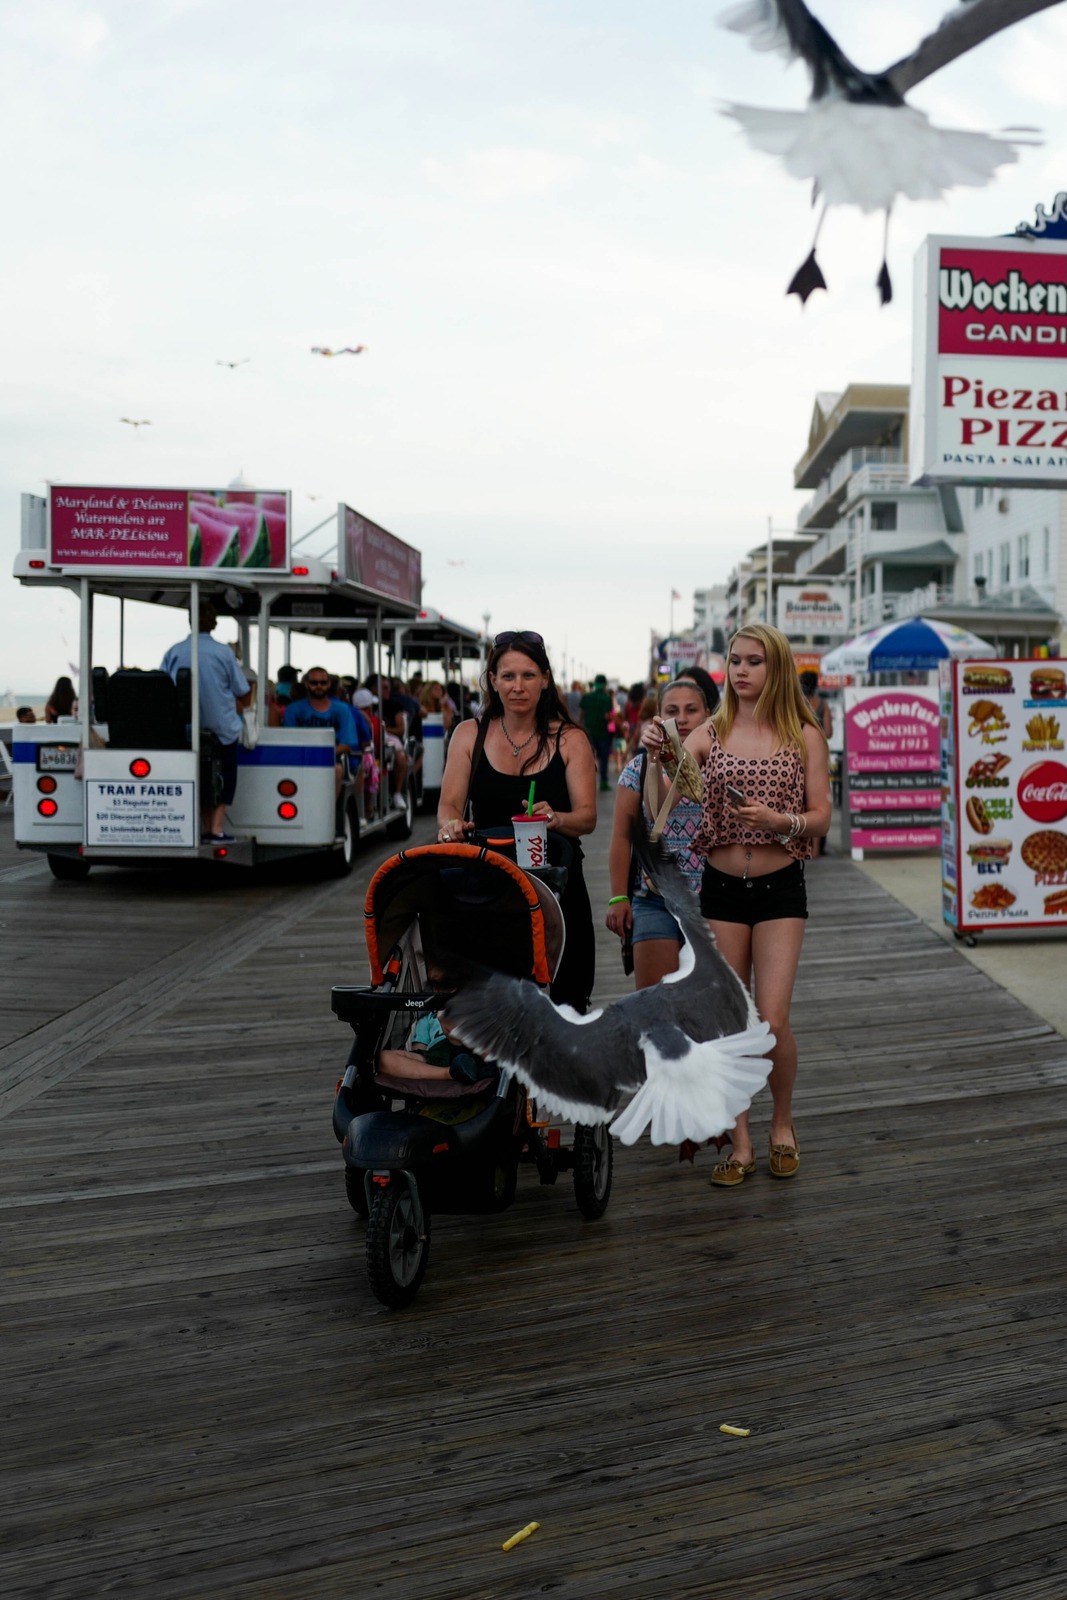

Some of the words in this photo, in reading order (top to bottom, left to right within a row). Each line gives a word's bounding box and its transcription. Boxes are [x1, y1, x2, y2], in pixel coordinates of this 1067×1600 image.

[965, 322, 1067, 344] CANDI
[942, 376, 1067, 412] Pieza
[943, 453, 995, 465] PASTA
[56, 494, 116, 511] Maryland
[116, 497, 129, 510] &
[132, 496, 184, 511] Delaware
[75, 510, 145, 526] Watermelons
[147, 516, 166, 526] are
[71, 527, 169, 541] MAR-DELicious
[786, 600, 842, 613] Boardwalk
[853, 699, 940, 729] Wockenfuss
[867, 724, 928, 737] CANDIES
[867, 738, 897, 751] Since
[900, 737, 929, 751] 1915
[965, 776, 1010, 789] GYROS
[98, 785, 136, 796] TRAM
[140, 785, 183, 797] FARES
[122, 799, 150, 809] Regular
[151, 799, 168, 807] Fare
[984, 797, 1014, 809] CHILI
[110, 813, 142, 821] Discount
[167, 813, 185, 821] Card
[886, 813, 913, 824] Covered
[985, 809, 1014, 821] DOGS
[110, 826, 144, 835] Unlimited
[145, 826, 162, 834] Ride
[163, 826, 181, 835] Pass
[871, 833, 907, 844] Caramel
[908, 832, 937, 844] Apples
[977, 862, 1003, 874] BLT
[1034, 869, 1067, 887] PIZZ
[1000, 909, 1029, 918] Pasta
[405, 999, 425, 1008] Jeep
